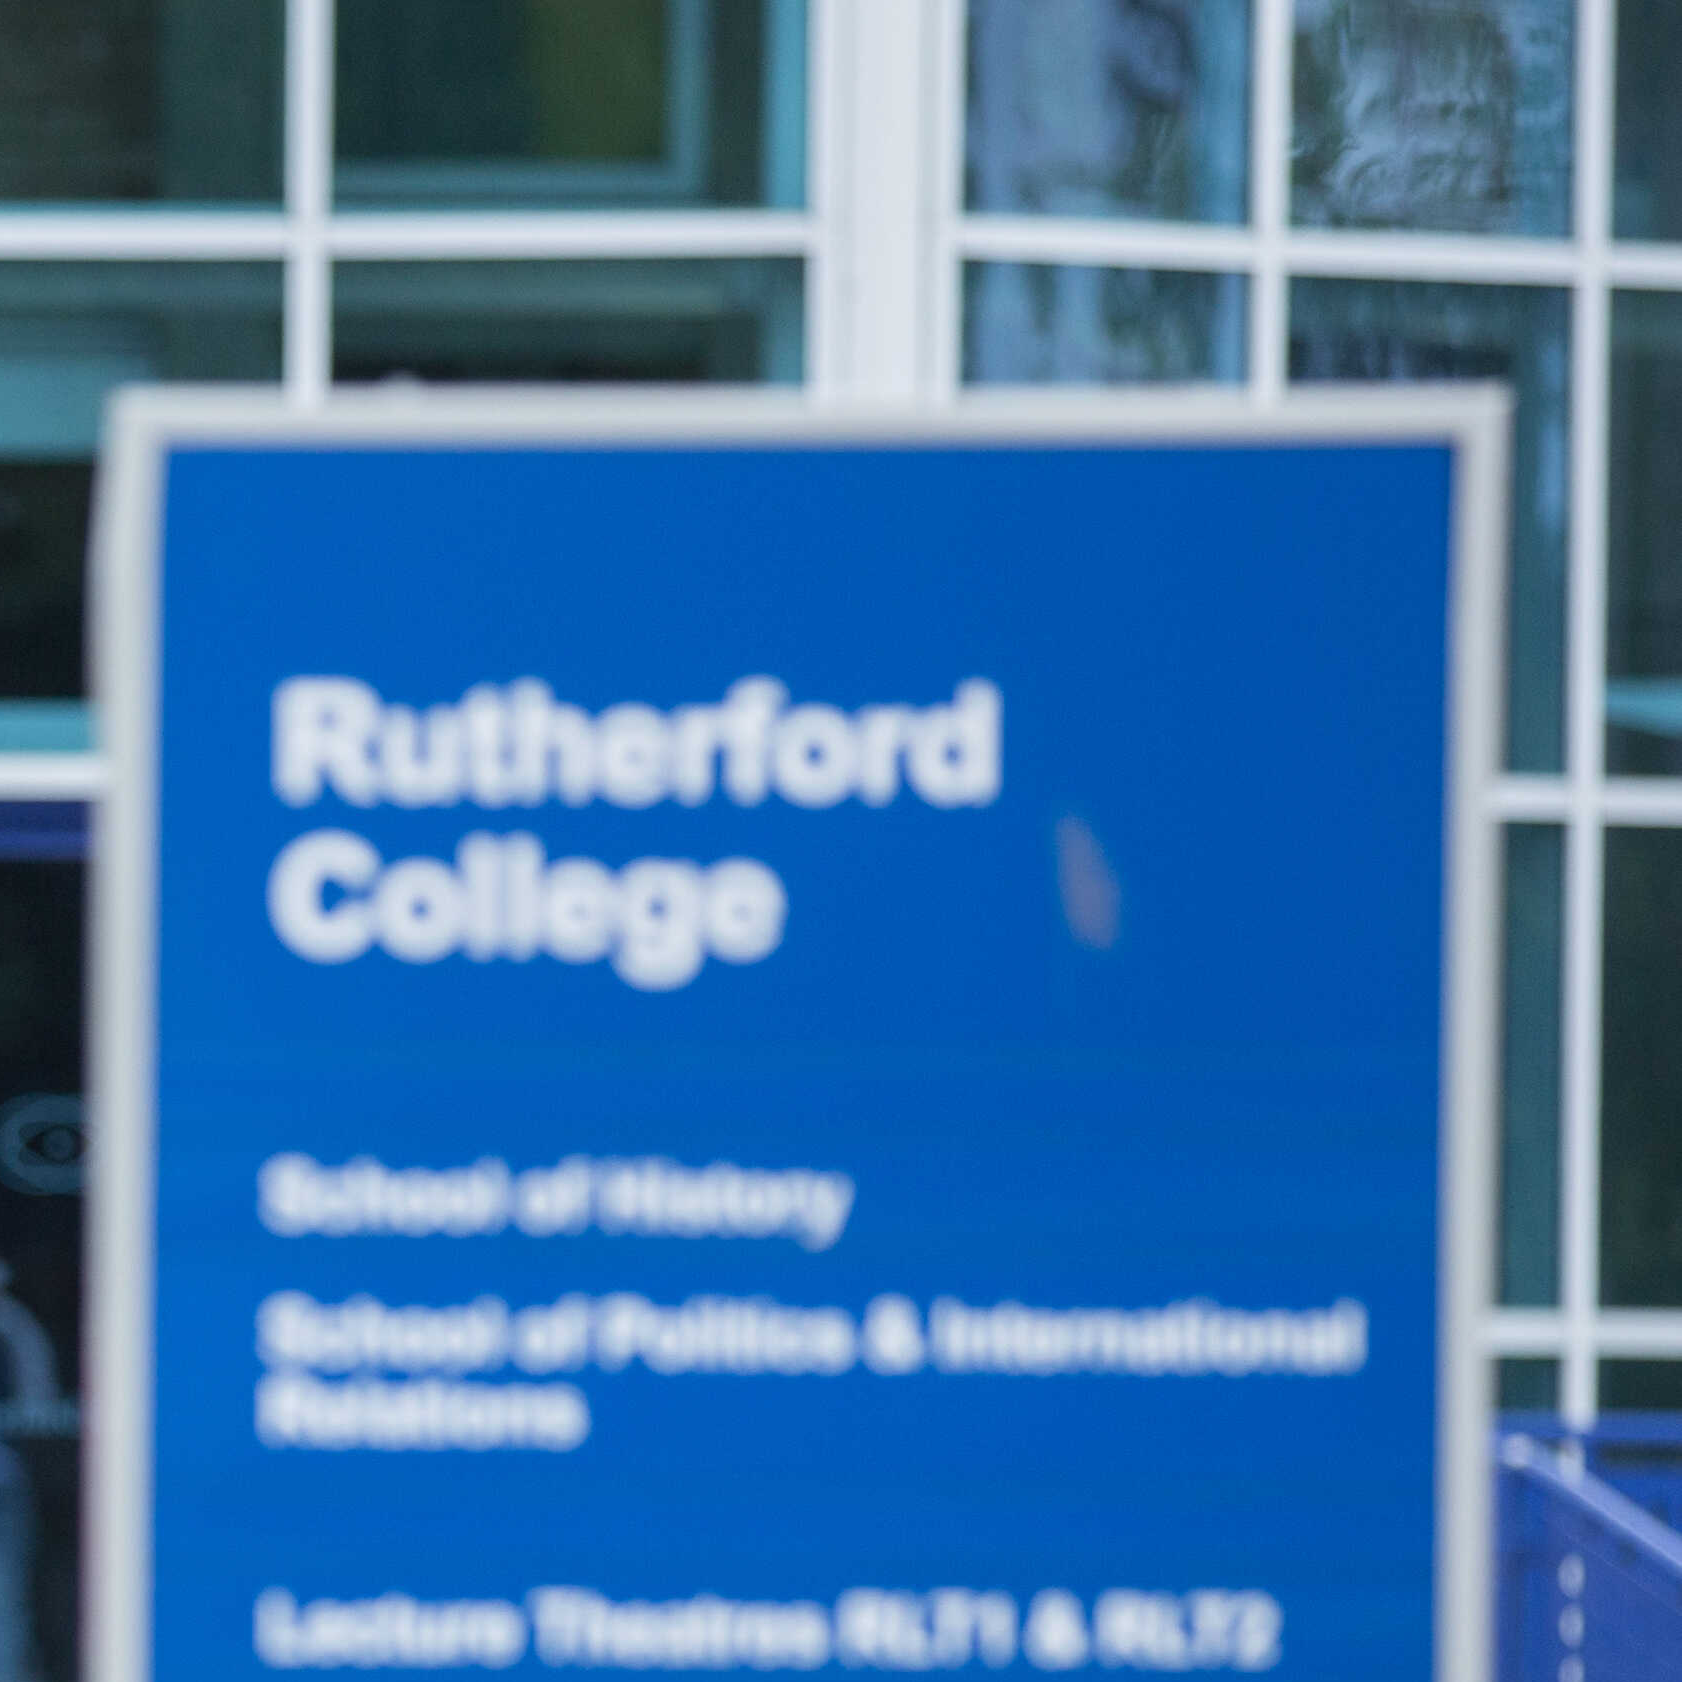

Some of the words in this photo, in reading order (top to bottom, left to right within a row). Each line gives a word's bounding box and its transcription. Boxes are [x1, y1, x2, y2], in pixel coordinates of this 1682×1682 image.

[273, 677, 1000, 806] Rutherford
[270, 831, 785, 989] College
[261, 1155, 510, 1234] School
[516, 1160, 592, 1233] of
[598, 1160, 852, 1246] History
[259, 1294, 509, 1371] School
[514, 1298, 589, 1371] of
[595, 1294, 856, 1372] Politics
[862, 1298, 922, 1372] &
[931, 1298, 1366, 1373] International
[257, 1378, 588, 1448] Relations
[255, 1588, 524, 1666] Lecture
[533, 1588, 828, 1667] Theatres
[1026, 1592, 1088, 1667] &
